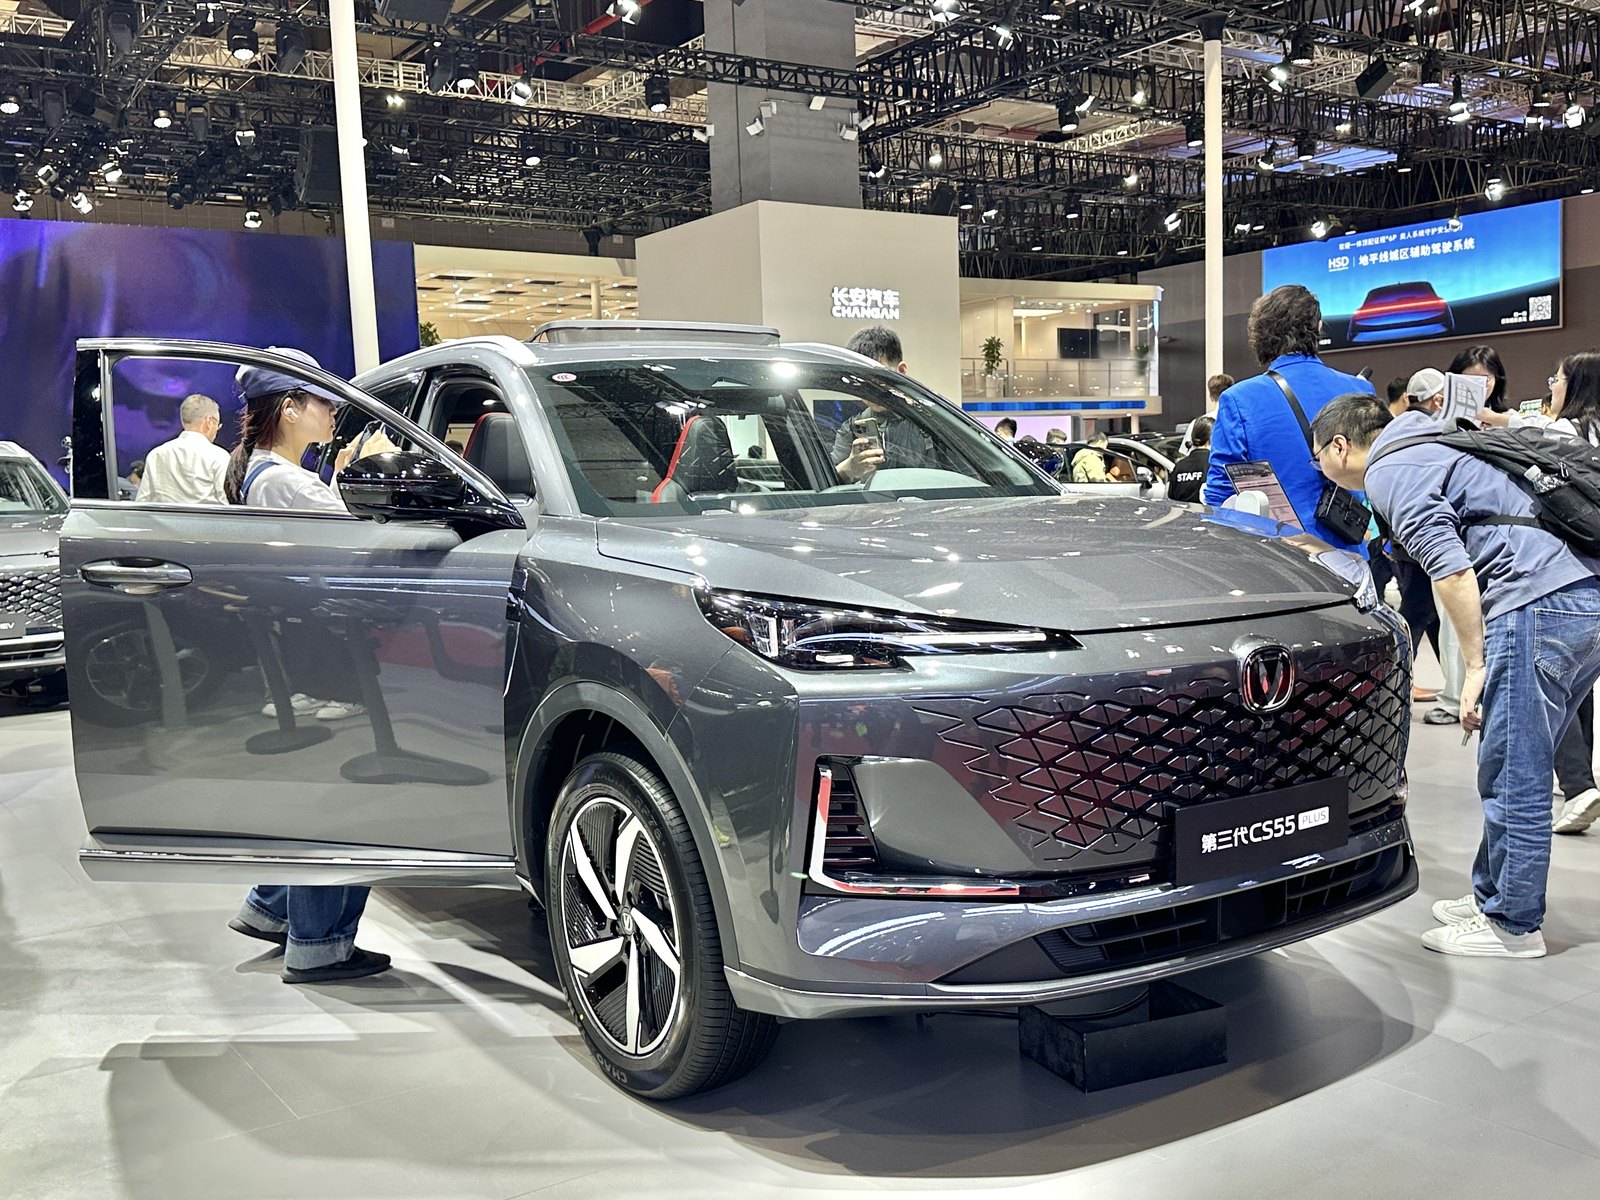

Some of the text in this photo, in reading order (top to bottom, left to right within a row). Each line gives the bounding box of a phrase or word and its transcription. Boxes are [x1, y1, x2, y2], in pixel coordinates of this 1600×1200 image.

[1328, 237, 1475, 269] HSD 地平线城区辅助驾驶系统
[832, 287, 899, 308] 长安汽车
[832, 306, 899, 319] CHANGAN
[1177, 472, 1203, 482] STAFF
[1302, 810, 1326, 825] PLUS
